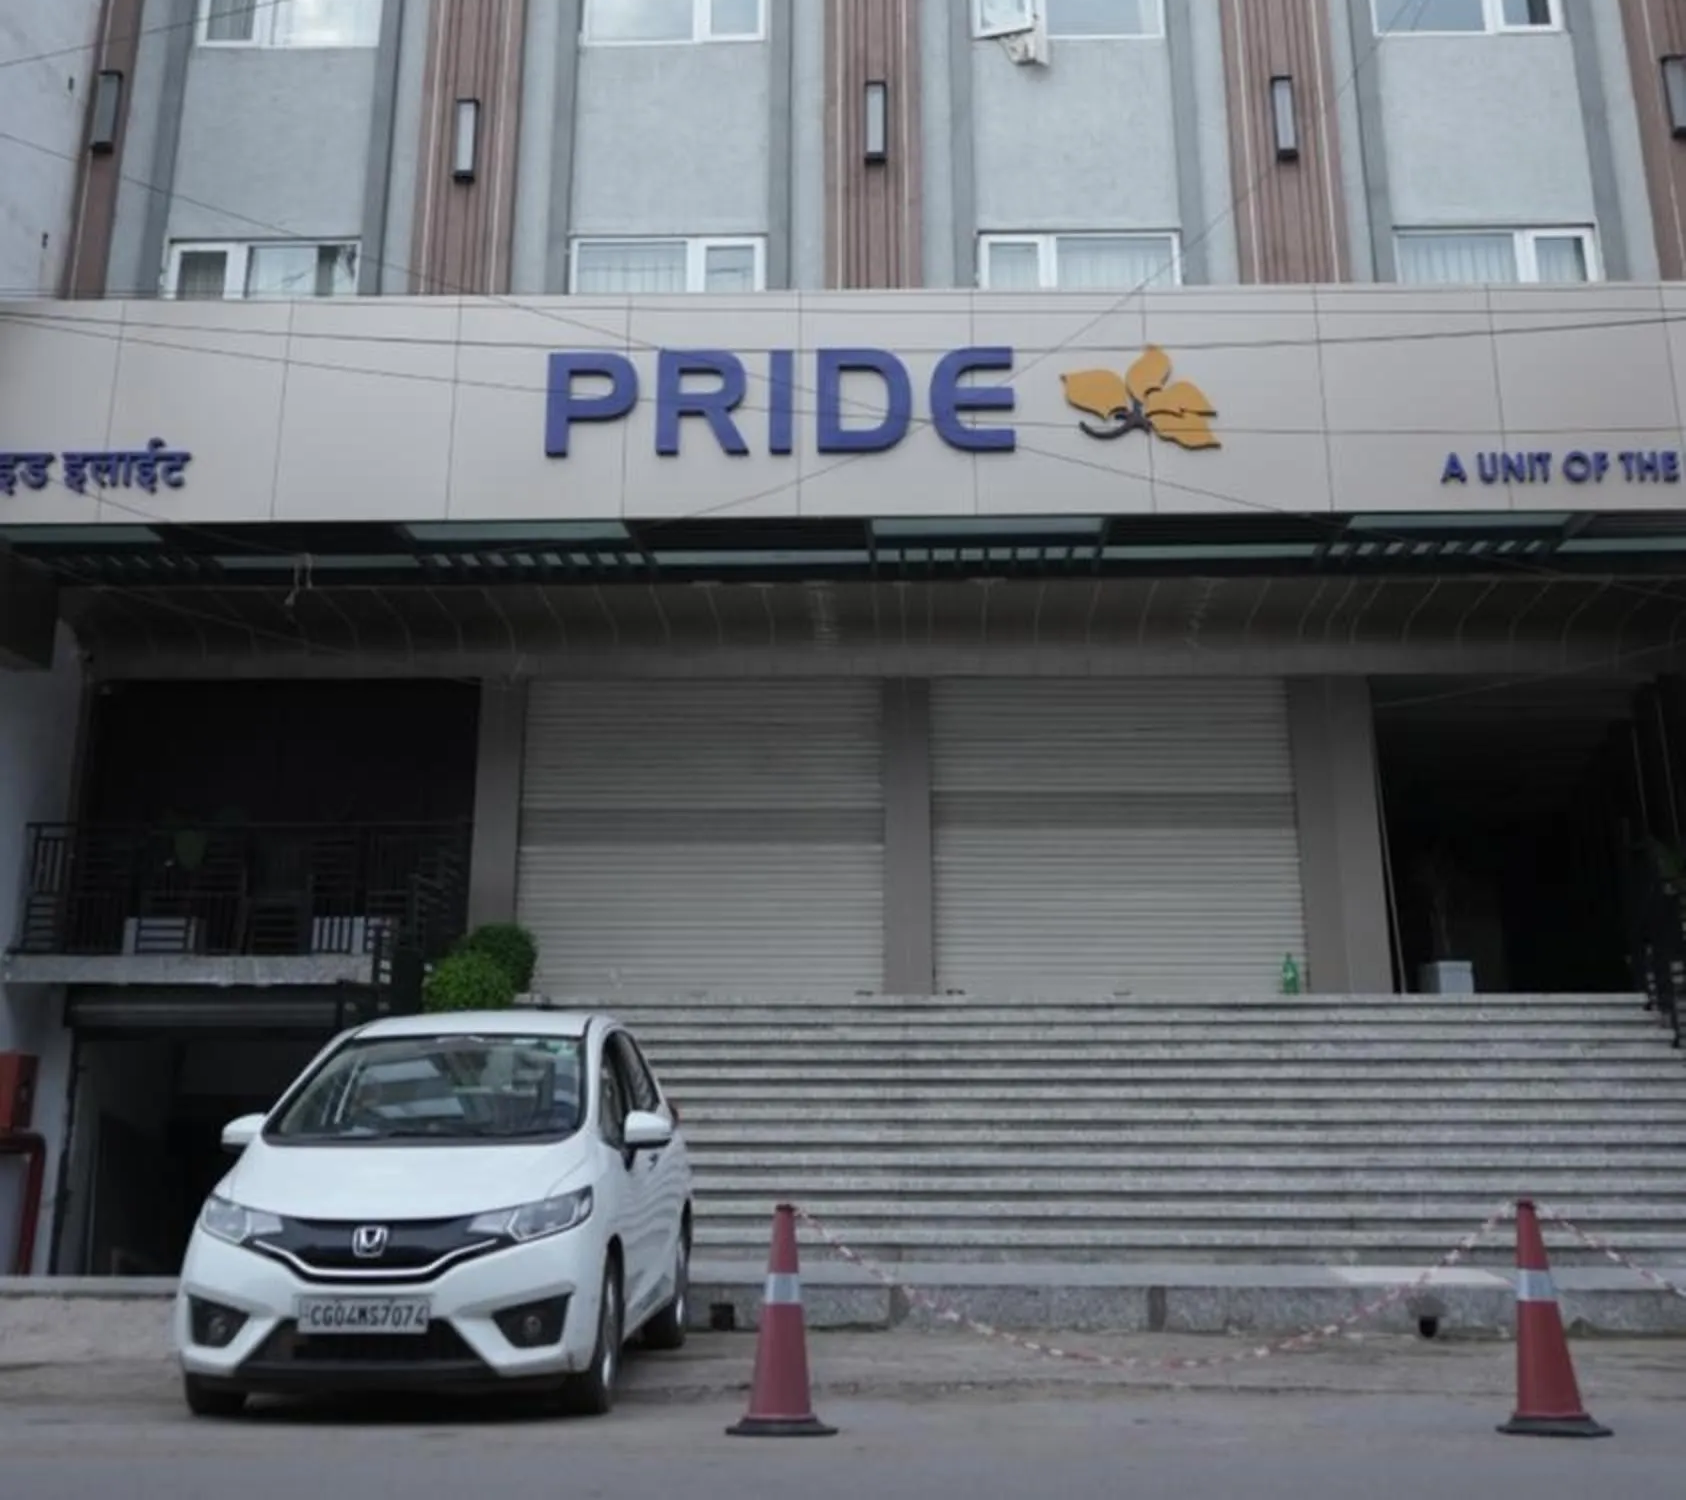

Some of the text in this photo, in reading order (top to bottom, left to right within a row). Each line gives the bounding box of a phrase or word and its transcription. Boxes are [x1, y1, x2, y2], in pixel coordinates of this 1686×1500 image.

[546, 346, 1017, 458] PRIDE
[1441, 450, 1682, 486] A UNIT OF THE
